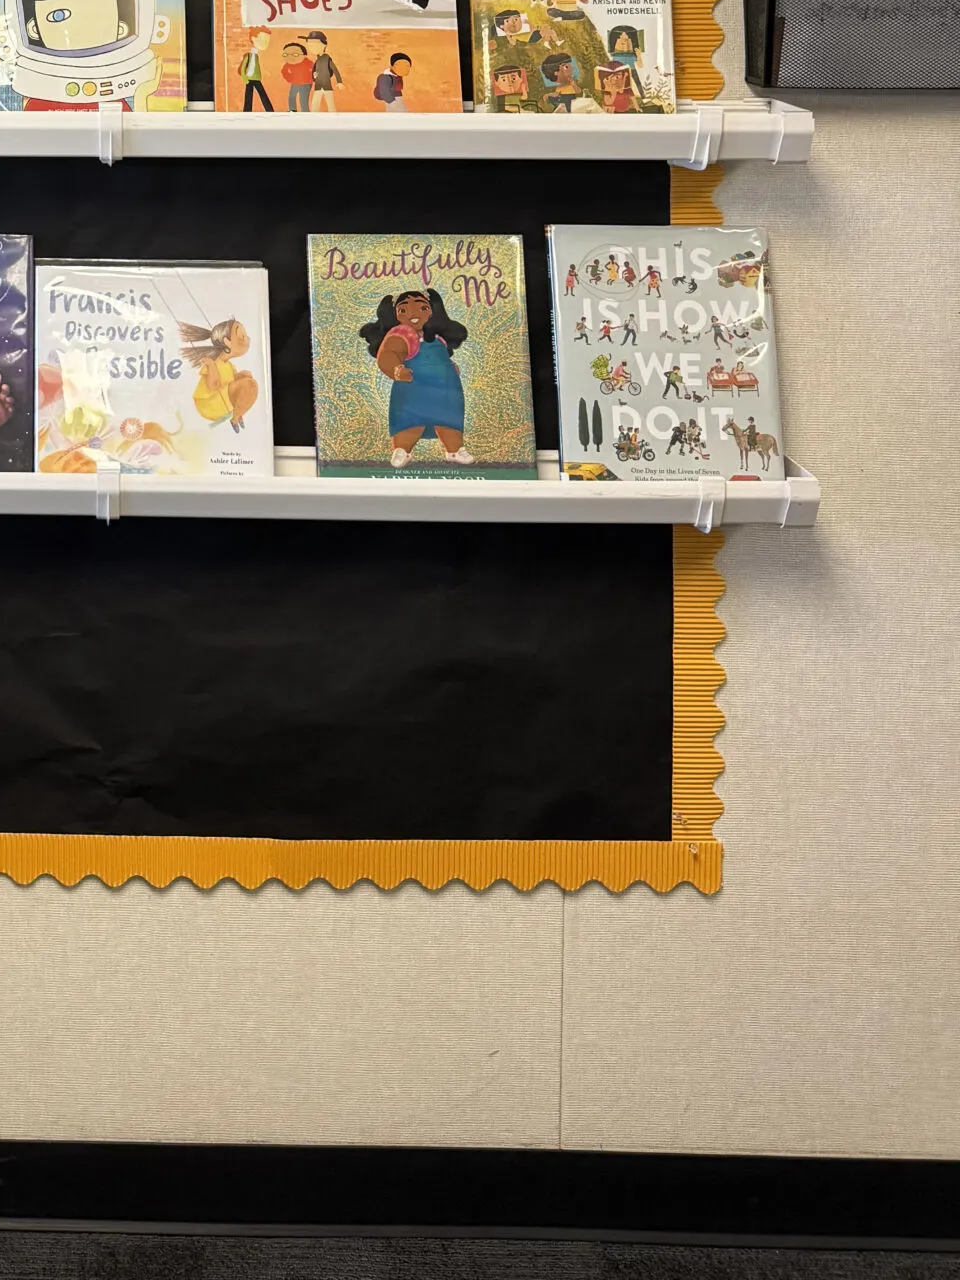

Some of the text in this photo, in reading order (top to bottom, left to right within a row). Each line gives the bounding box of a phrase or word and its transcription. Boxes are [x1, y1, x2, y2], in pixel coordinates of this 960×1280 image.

[320, 239, 502, 286] Beautifully
[609, 247, 712, 281] THIS
[49, 280, 152, 316] Francis
[452, 275, 511, 307] Me
[65, 320, 164, 343] Discovers
[582, 298, 749, 333] IS HOW
[85, 346, 183, 380] ssible
[634, 352, 702, 386] WE
[611, 405, 734, 441] DO IT
[645, 467, 656, 475] Day
